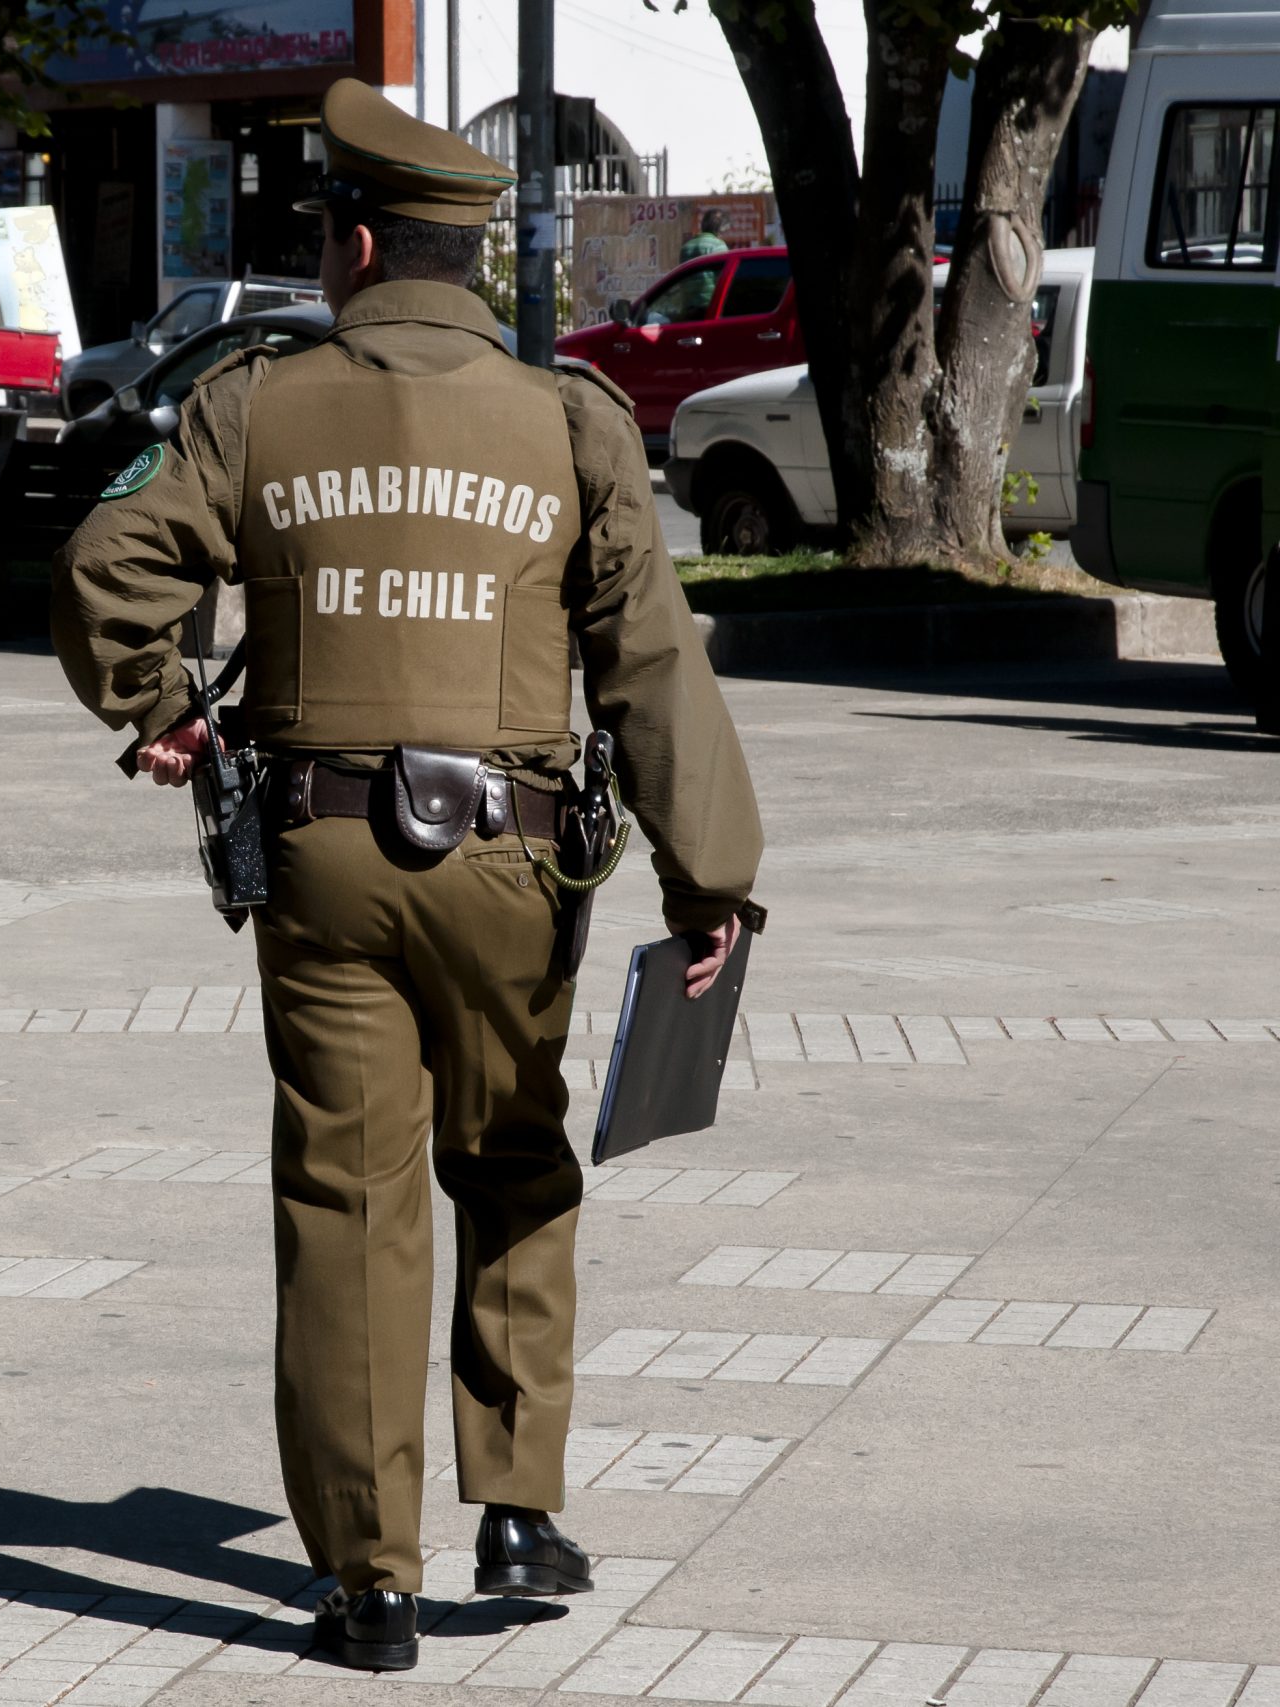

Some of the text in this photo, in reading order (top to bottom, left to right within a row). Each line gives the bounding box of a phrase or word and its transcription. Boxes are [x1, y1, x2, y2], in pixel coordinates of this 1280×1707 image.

[636, 202, 678, 221] 2015
[261, 466, 563, 544] CARABINEROS
[316, 567, 497, 623] DE CHILE
